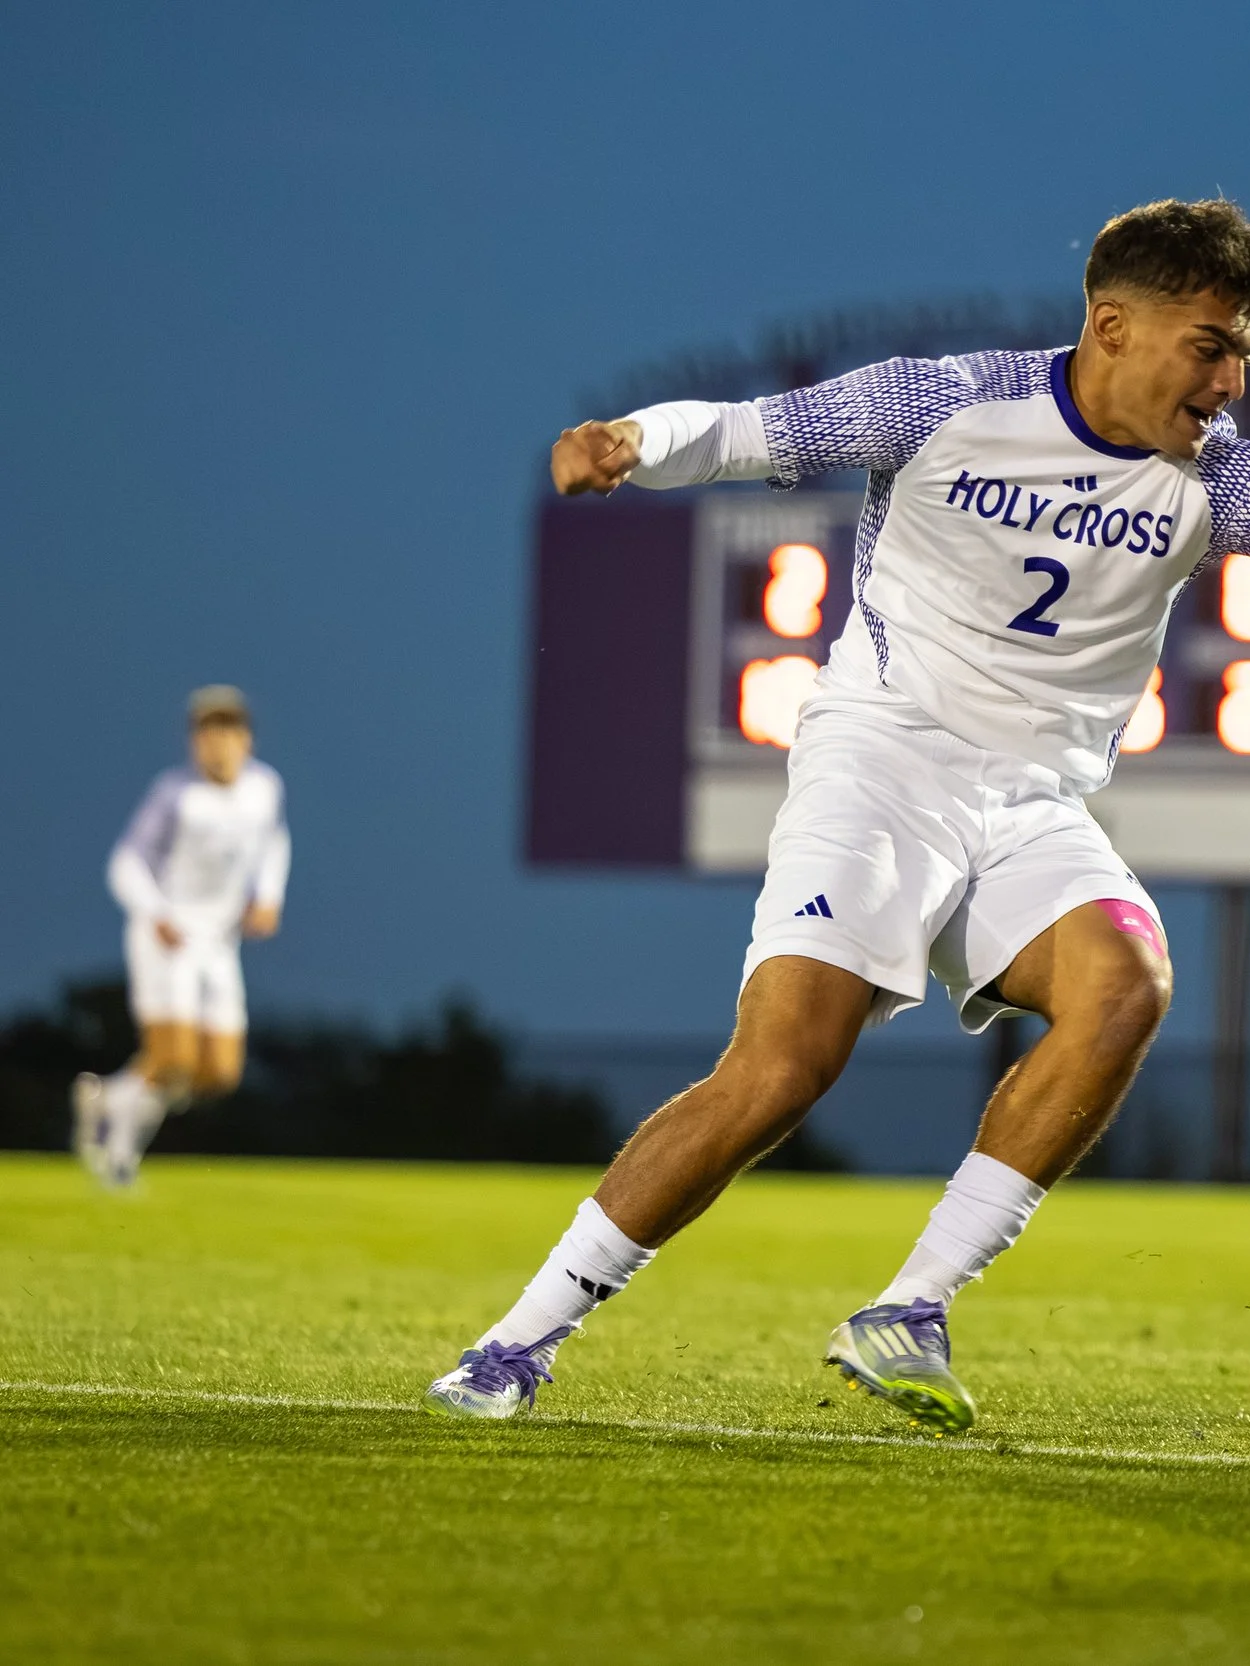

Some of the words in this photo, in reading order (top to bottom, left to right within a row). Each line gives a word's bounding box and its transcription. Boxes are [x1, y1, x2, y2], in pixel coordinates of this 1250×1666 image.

[946, 470, 1053, 532] HOLY
[1053, 502, 1173, 557] CROSS
[1006, 556, 1070, 637] 2
